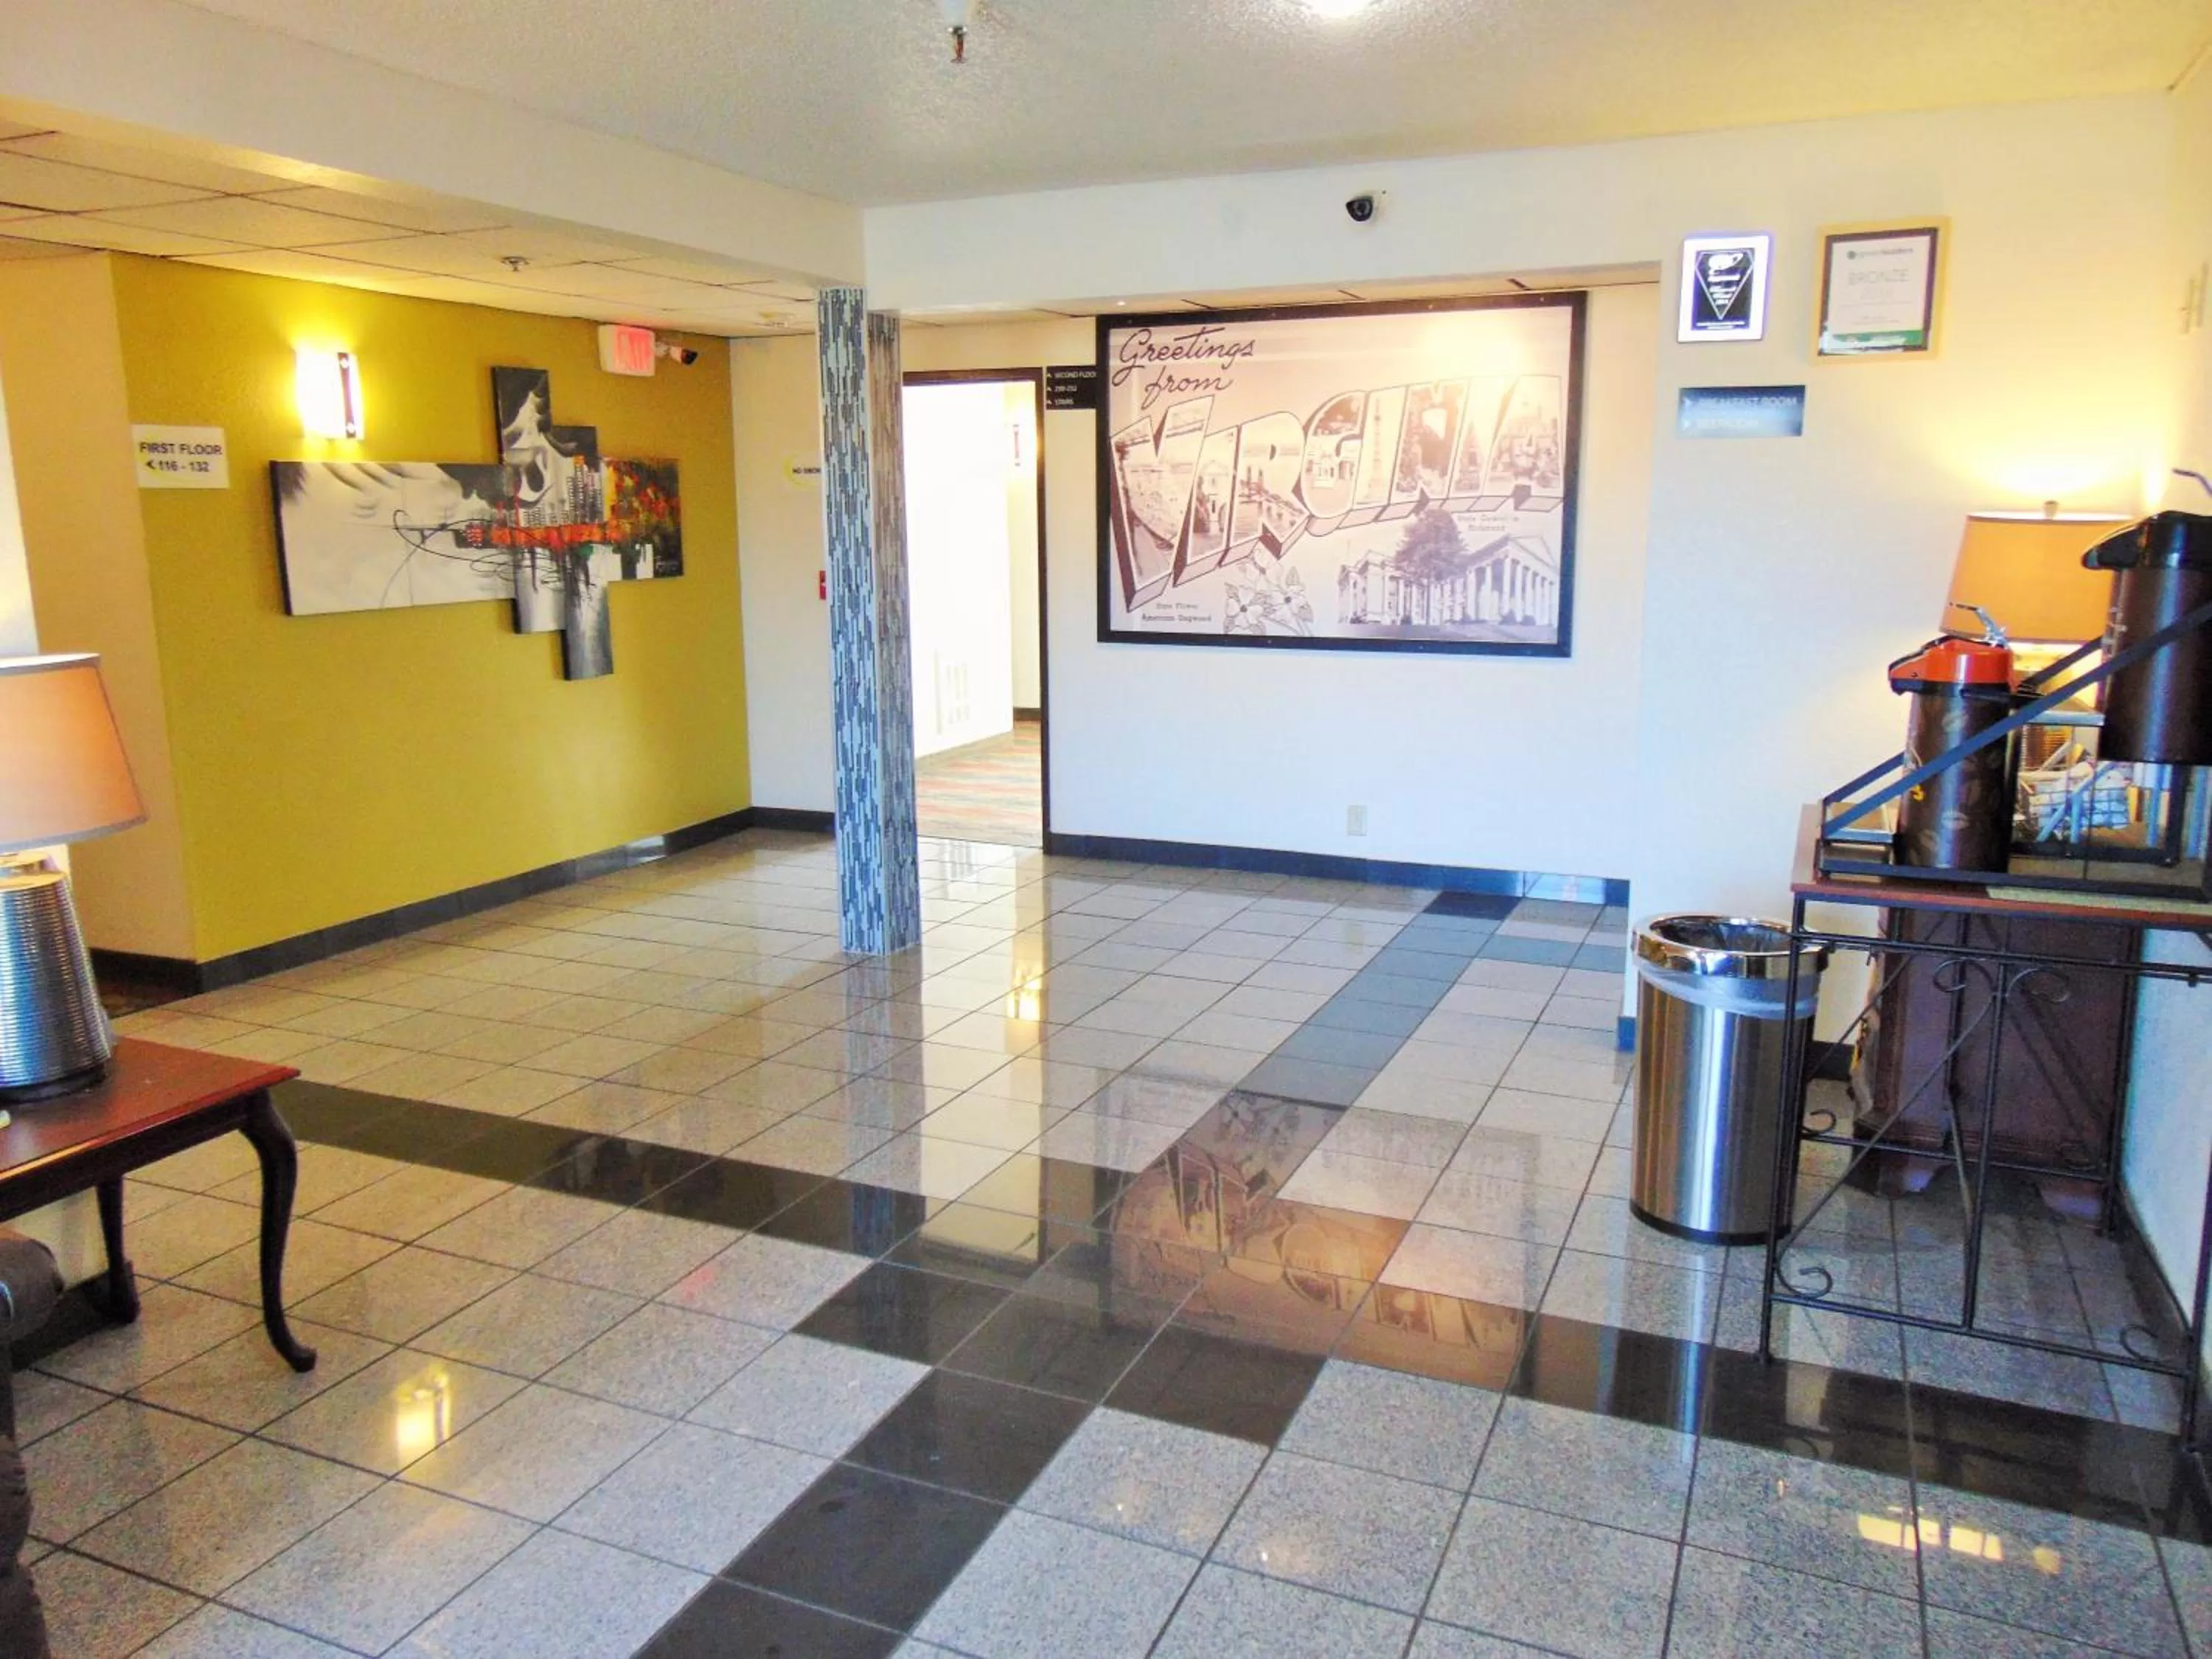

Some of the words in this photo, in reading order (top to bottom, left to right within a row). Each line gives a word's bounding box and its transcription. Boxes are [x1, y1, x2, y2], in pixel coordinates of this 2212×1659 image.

[1112, 327, 1255, 386] Greetings
[1141, 366, 1233, 410] from
[139, 442, 175, 453] FIRST
[179, 443, 223, 455] FLOOR
[158, 460, 178, 471] 116
[189, 461, 209, 472] 132
[1110, 375, 1564, 613] VIRGINIA
